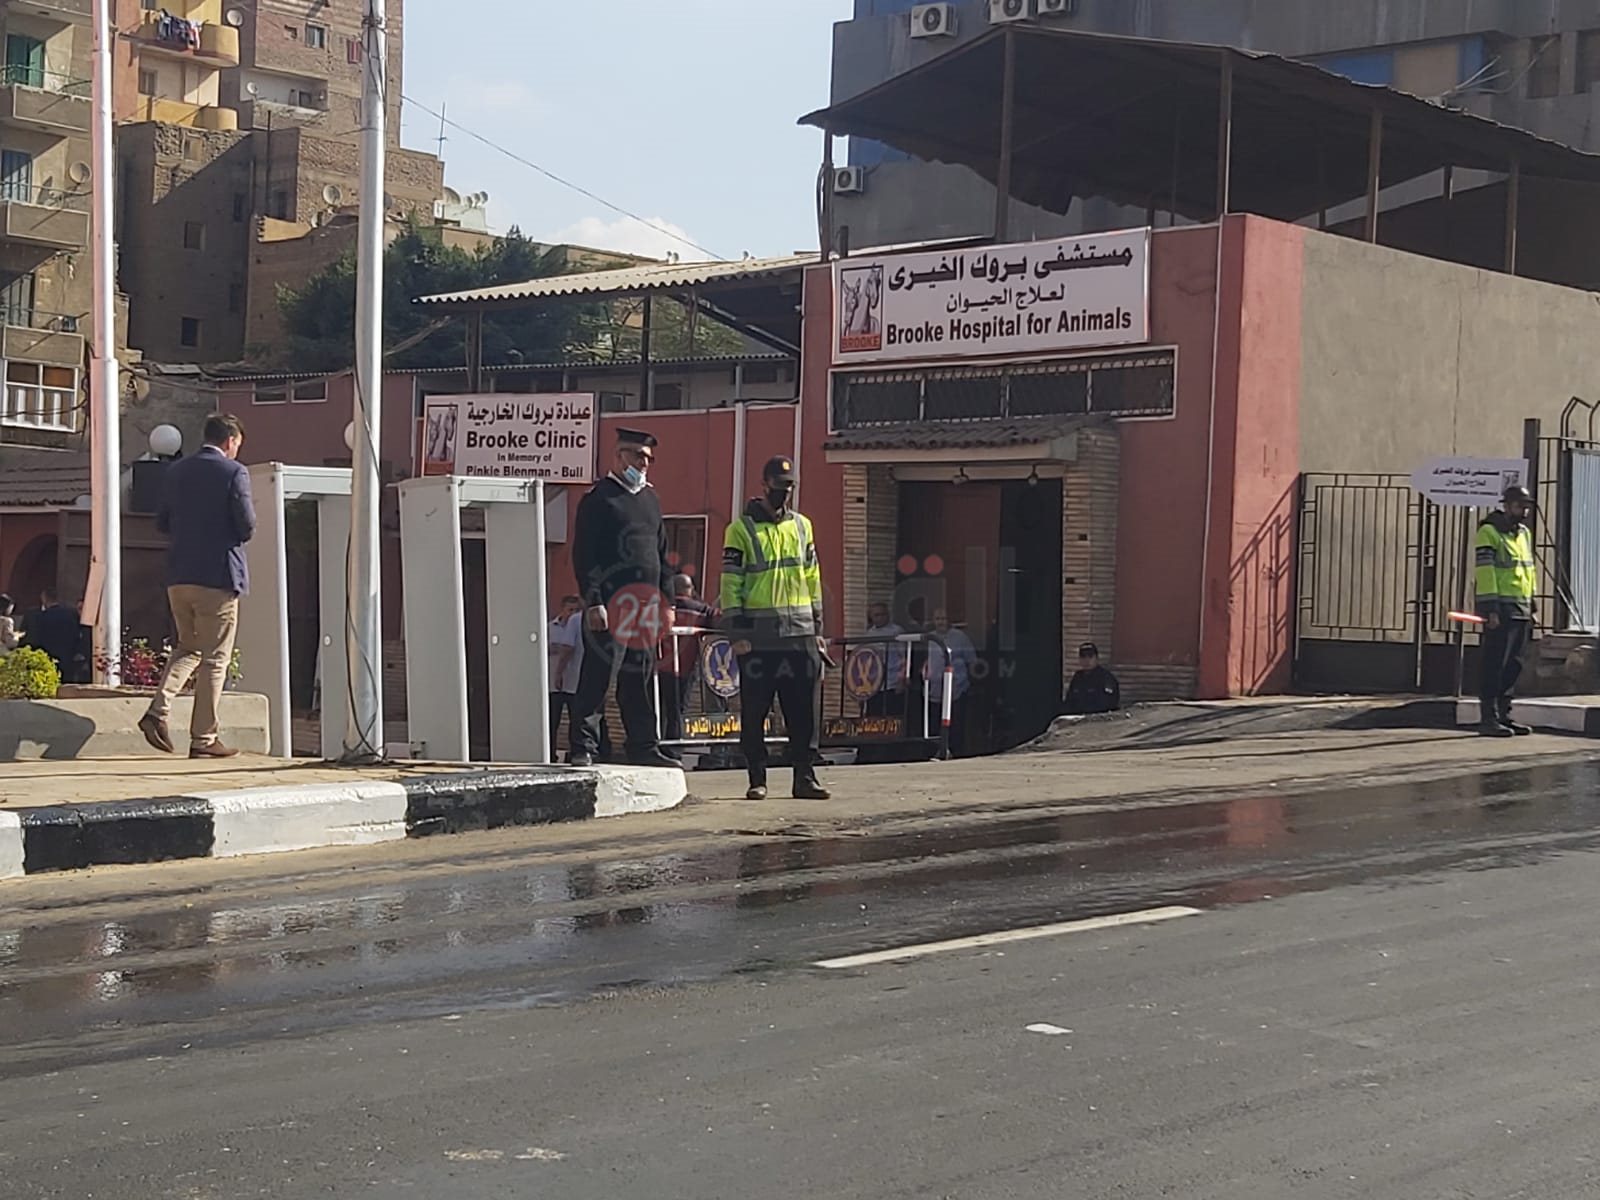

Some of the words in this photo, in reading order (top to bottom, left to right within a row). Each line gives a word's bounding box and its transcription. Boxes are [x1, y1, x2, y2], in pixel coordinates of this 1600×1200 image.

[970, 253, 1027, 283] بروك
[1035, 244, 1132, 277] مستشفى
[946, 287, 1012, 313] الحيوان
[1015, 284, 1065, 309] لعلاج
[887, 320, 944, 344] Brooke
[950, 314, 1021, 343] Hospital
[1027, 312, 1051, 335] for
[1057, 307, 1131, 332] Animals
[467, 401, 520, 426] الخارجية
[522, 402, 555, 426] بروك
[556, 402, 591, 425] عيادة
[466, 431, 528, 448] Brooke
[535, 431, 587, 448] Clinic
[497, 453, 506, 461] In
[508, 453, 541, 463] Memory
[543, 453, 552, 462] of
[503, 466, 551, 477] Blenman
[561, 466, 584, 478] Bull
